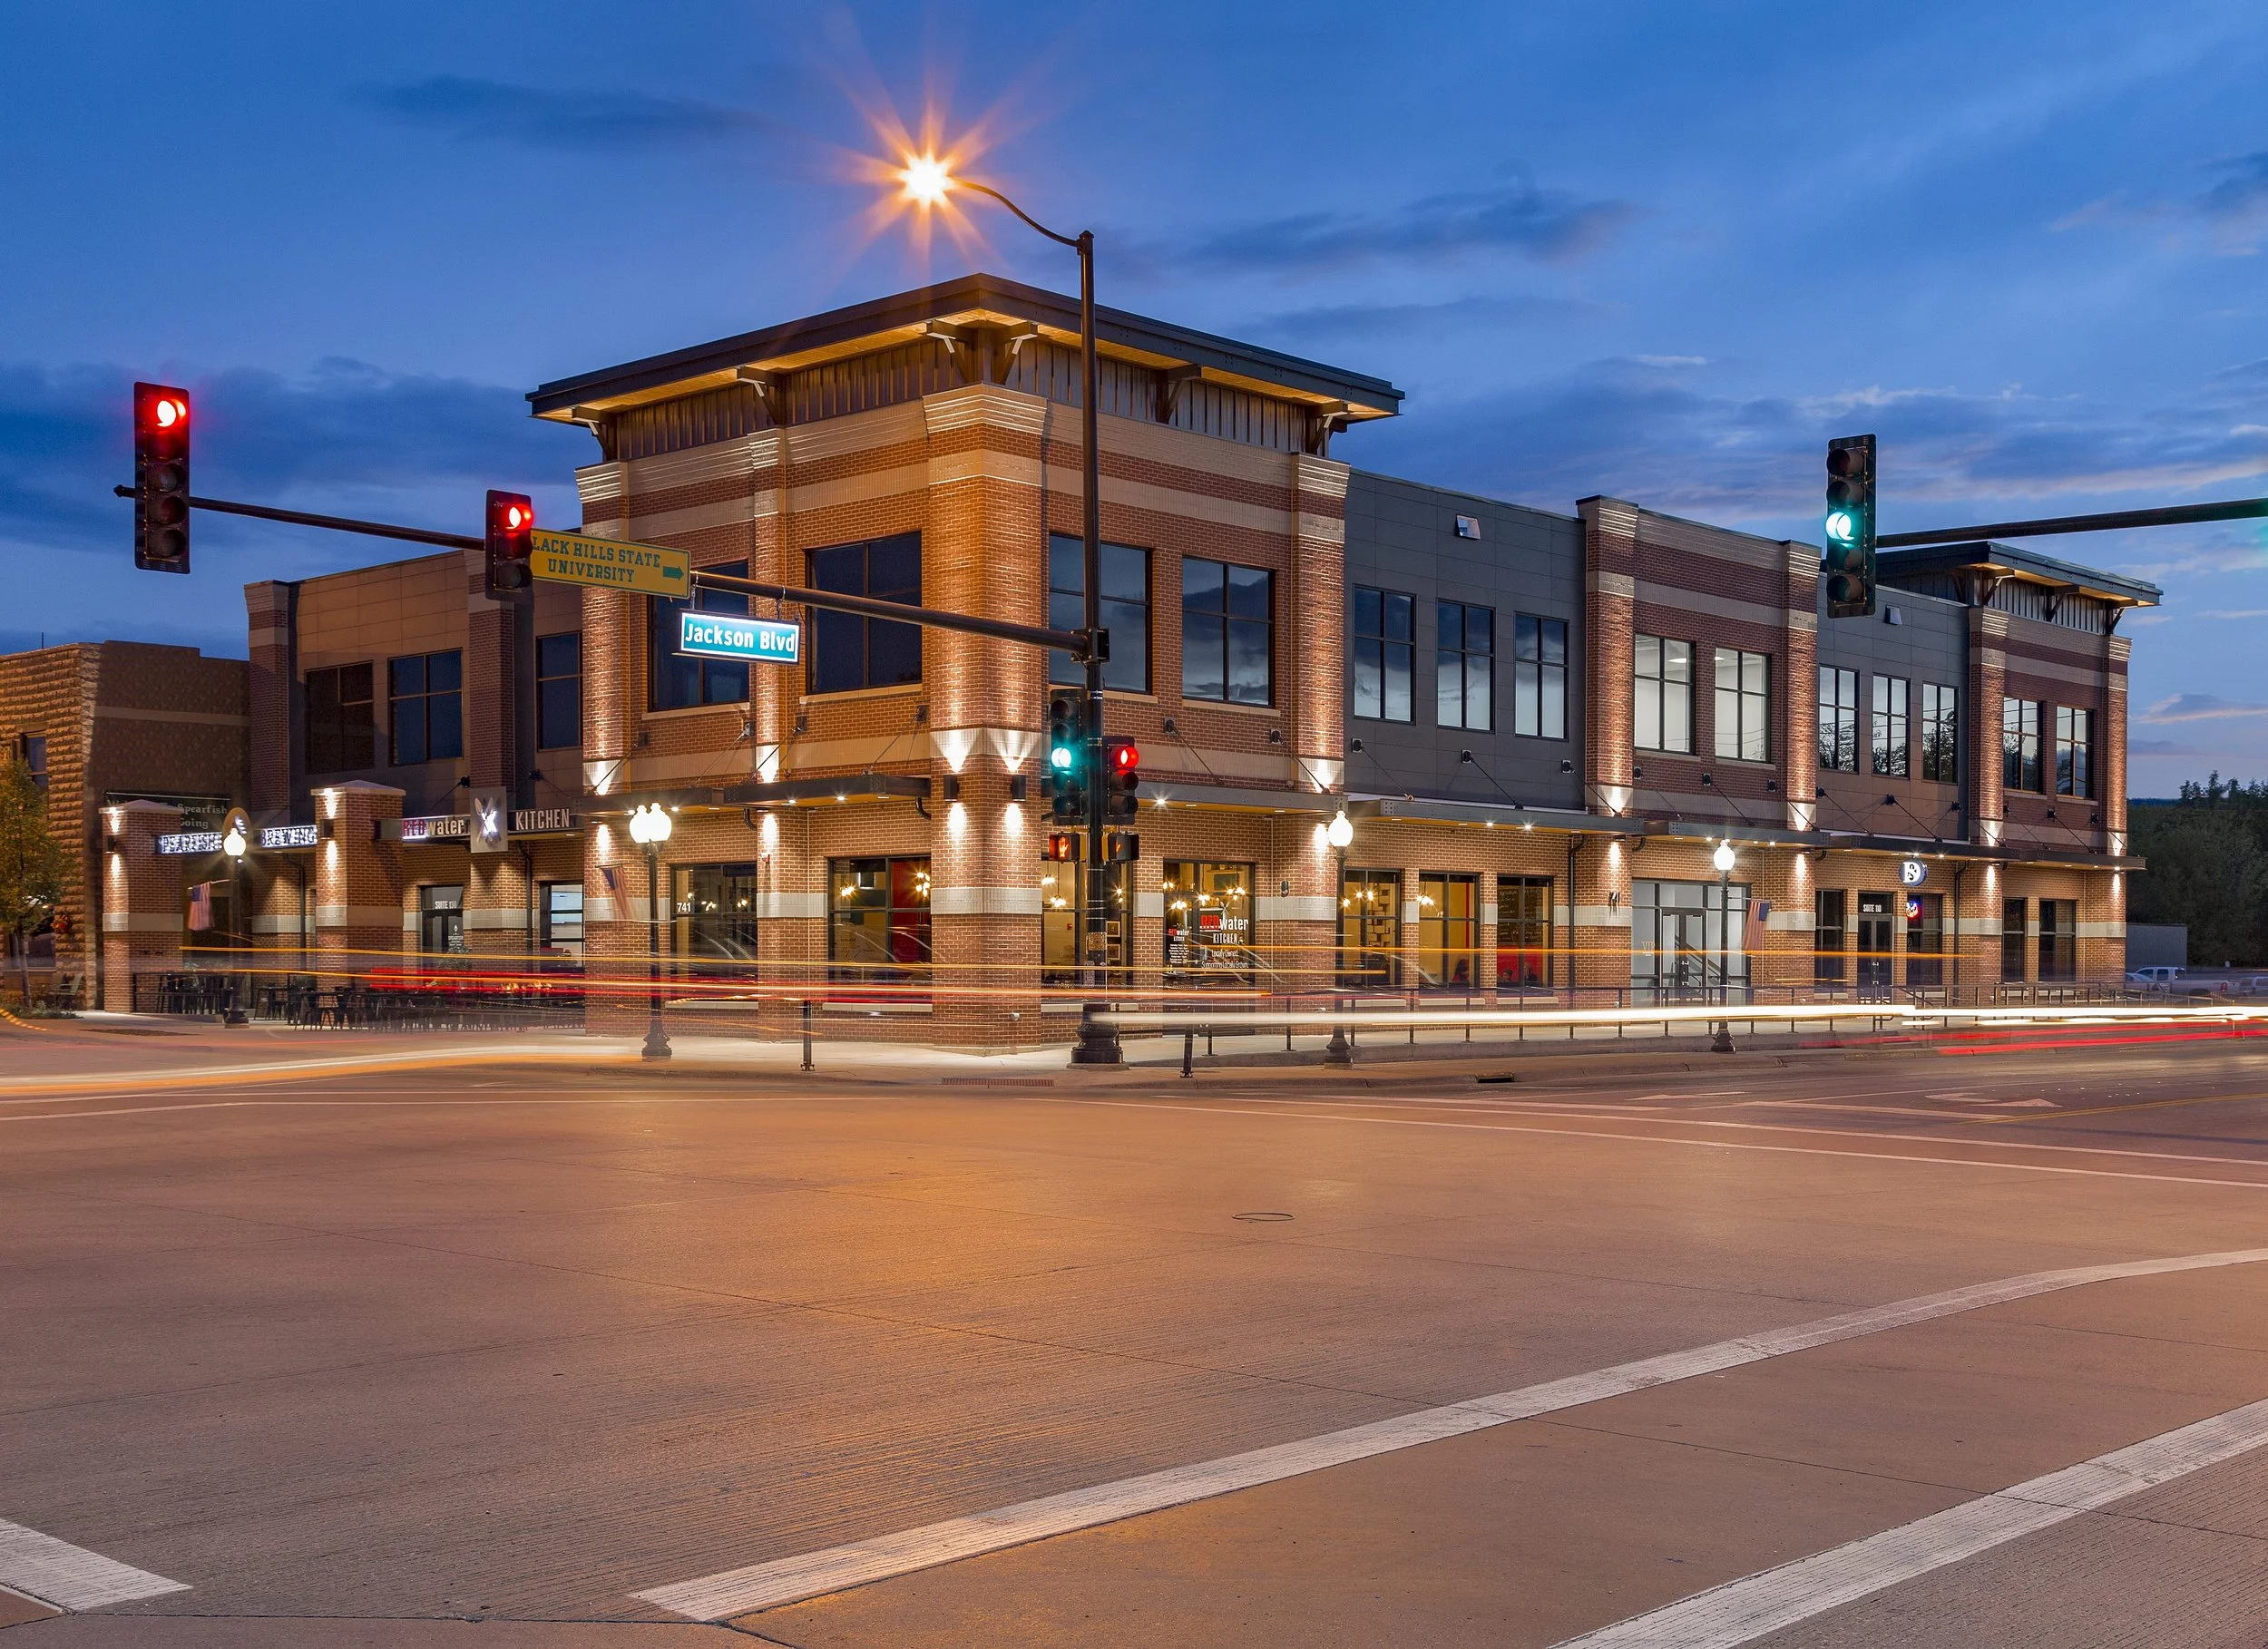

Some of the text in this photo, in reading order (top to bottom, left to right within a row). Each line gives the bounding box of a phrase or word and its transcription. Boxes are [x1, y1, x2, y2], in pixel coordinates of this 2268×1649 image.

[533, 536, 660, 568] LACK HILLS STATE
[548, 559, 635, 582] UNIVERSITY
[685, 623, 795, 652] Jackson Blvd
[515, 808, 570, 831] KITCHEN
[677, 902, 691, 912] 741
